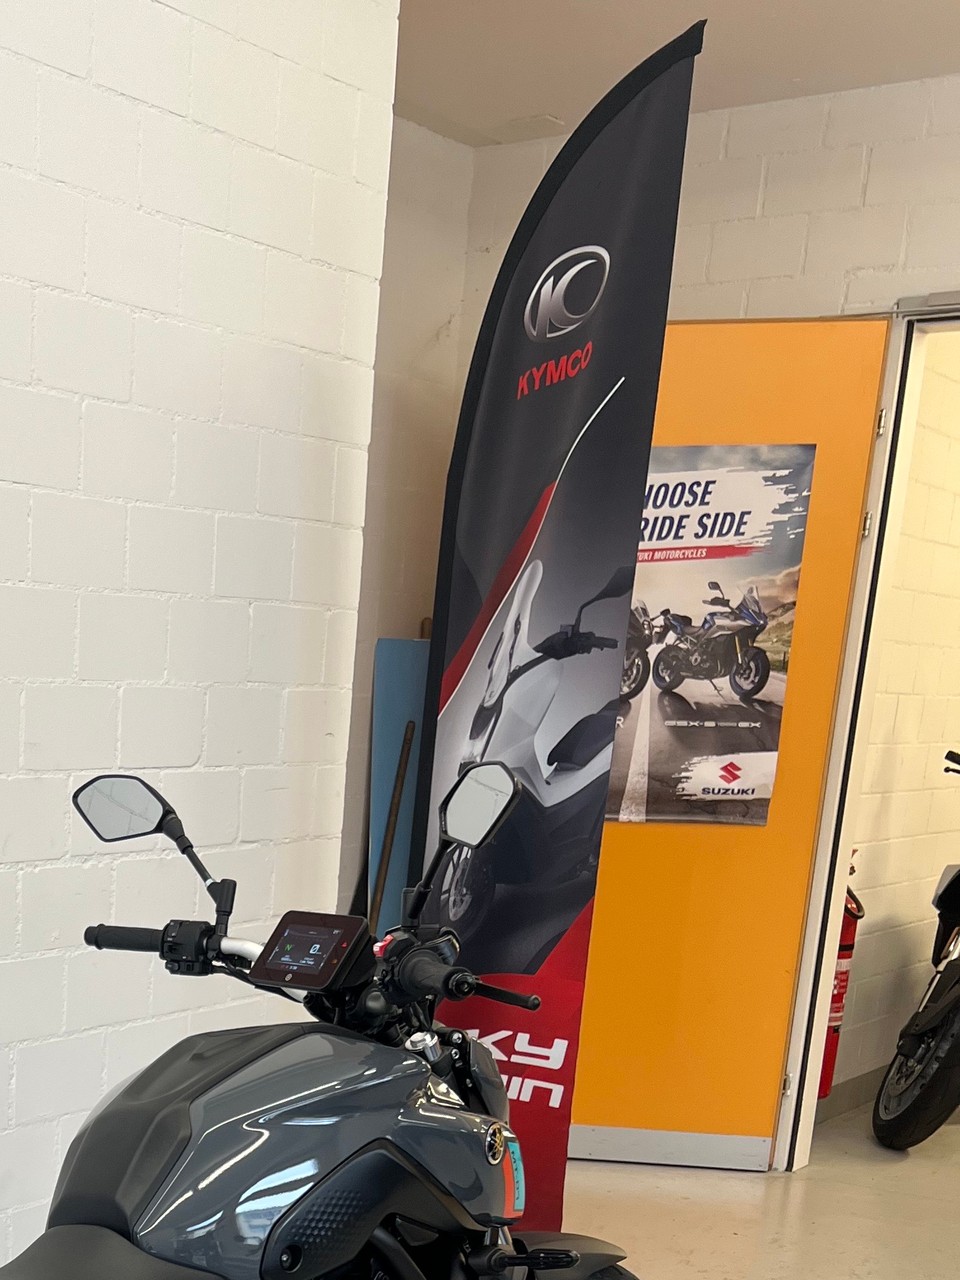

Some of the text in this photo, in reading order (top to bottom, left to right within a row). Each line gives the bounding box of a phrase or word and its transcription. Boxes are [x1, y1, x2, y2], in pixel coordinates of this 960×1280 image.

[517, 340, 593, 400] KYMCO
[643, 480, 717, 510] OOSE
[694, 510, 752, 540] SIDE
[654, 548, 707, 560] MOTORCYCLES
[701, 787, 756, 796] SUZUKI
